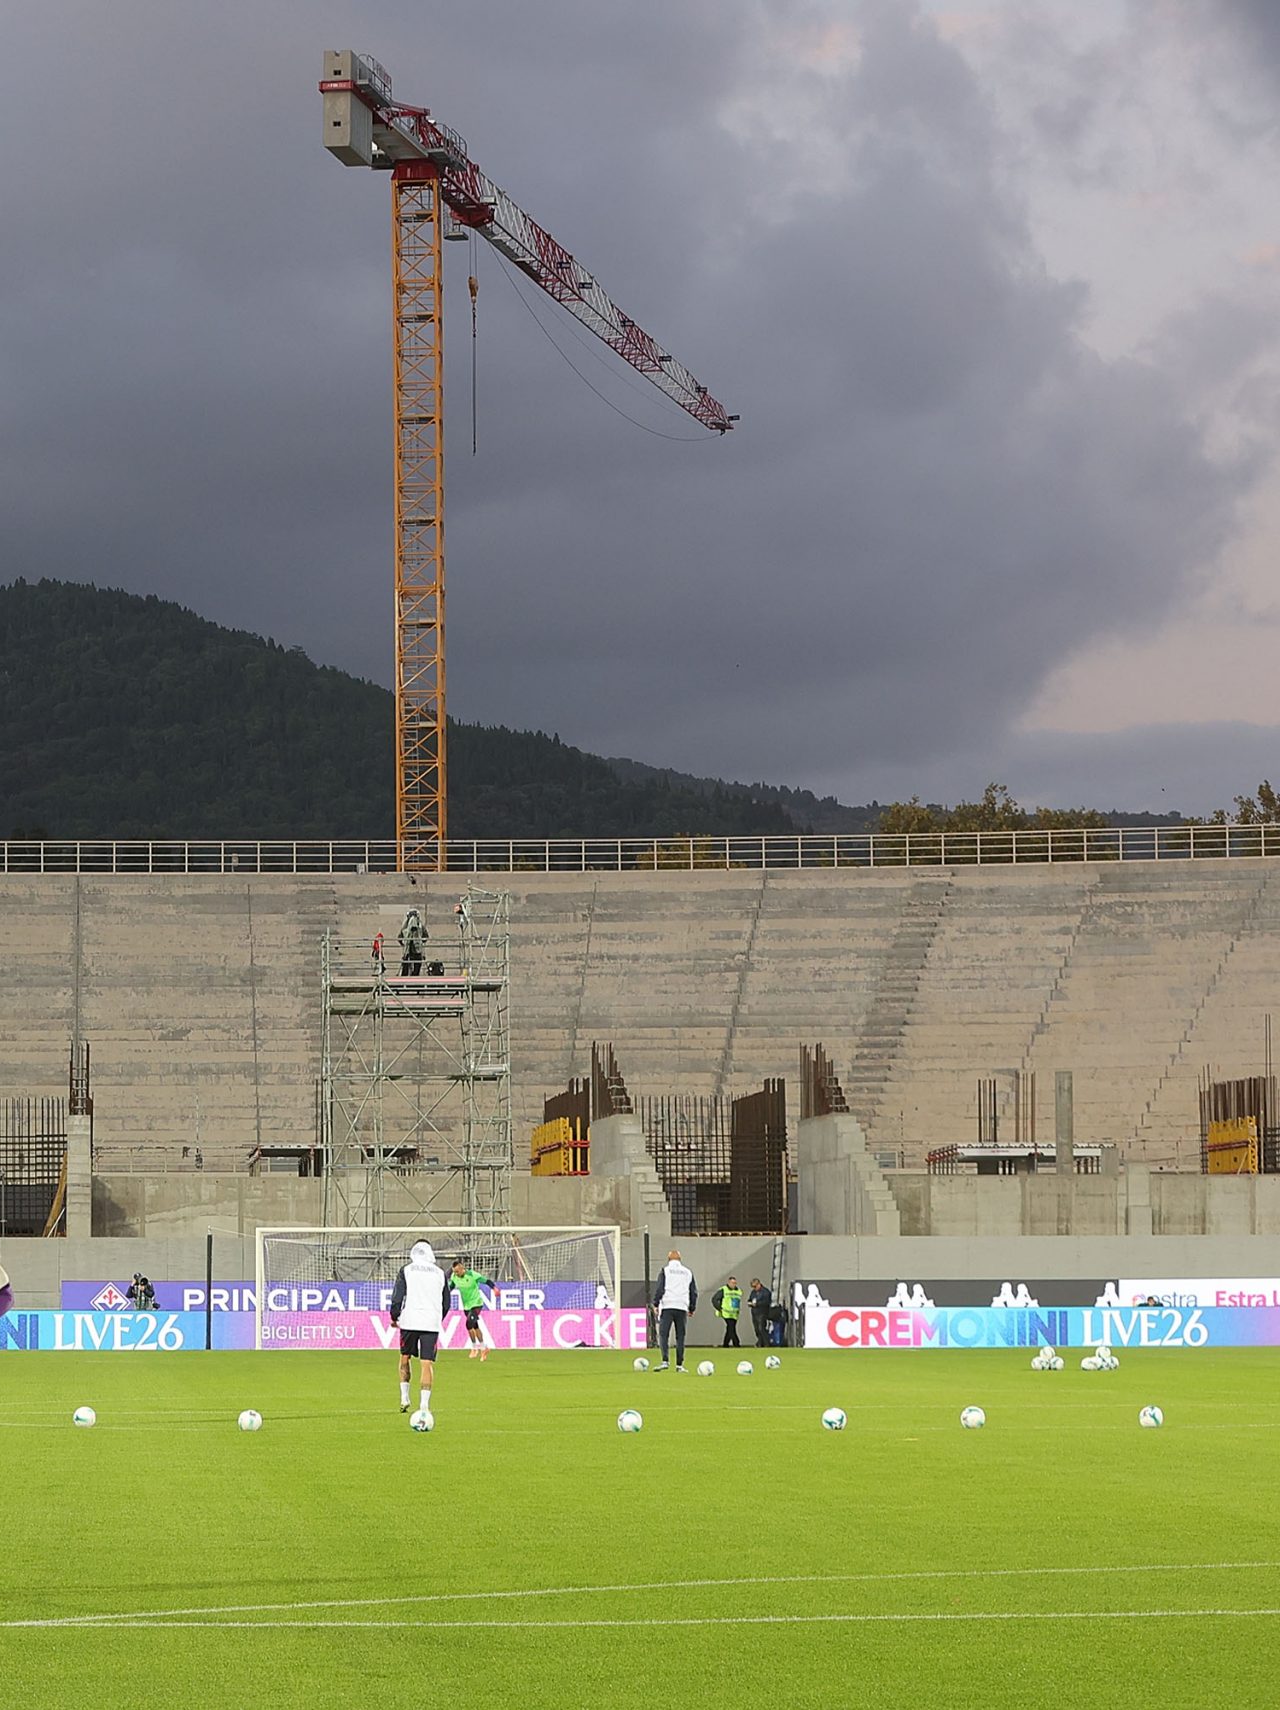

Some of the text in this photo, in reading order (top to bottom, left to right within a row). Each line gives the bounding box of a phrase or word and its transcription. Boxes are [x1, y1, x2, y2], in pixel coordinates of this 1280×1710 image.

[183, 1288, 368, 1311] PRINCIPAL
[1215, 1291, 1267, 1307] Estra
[53, 1313, 185, 1350] LIVE26
[262, 1325, 331, 1340] BIGLIETTI
[334, 1325, 356, 1340] SU
[827, 1309, 1209, 1347] CREMONINI LIVE26
